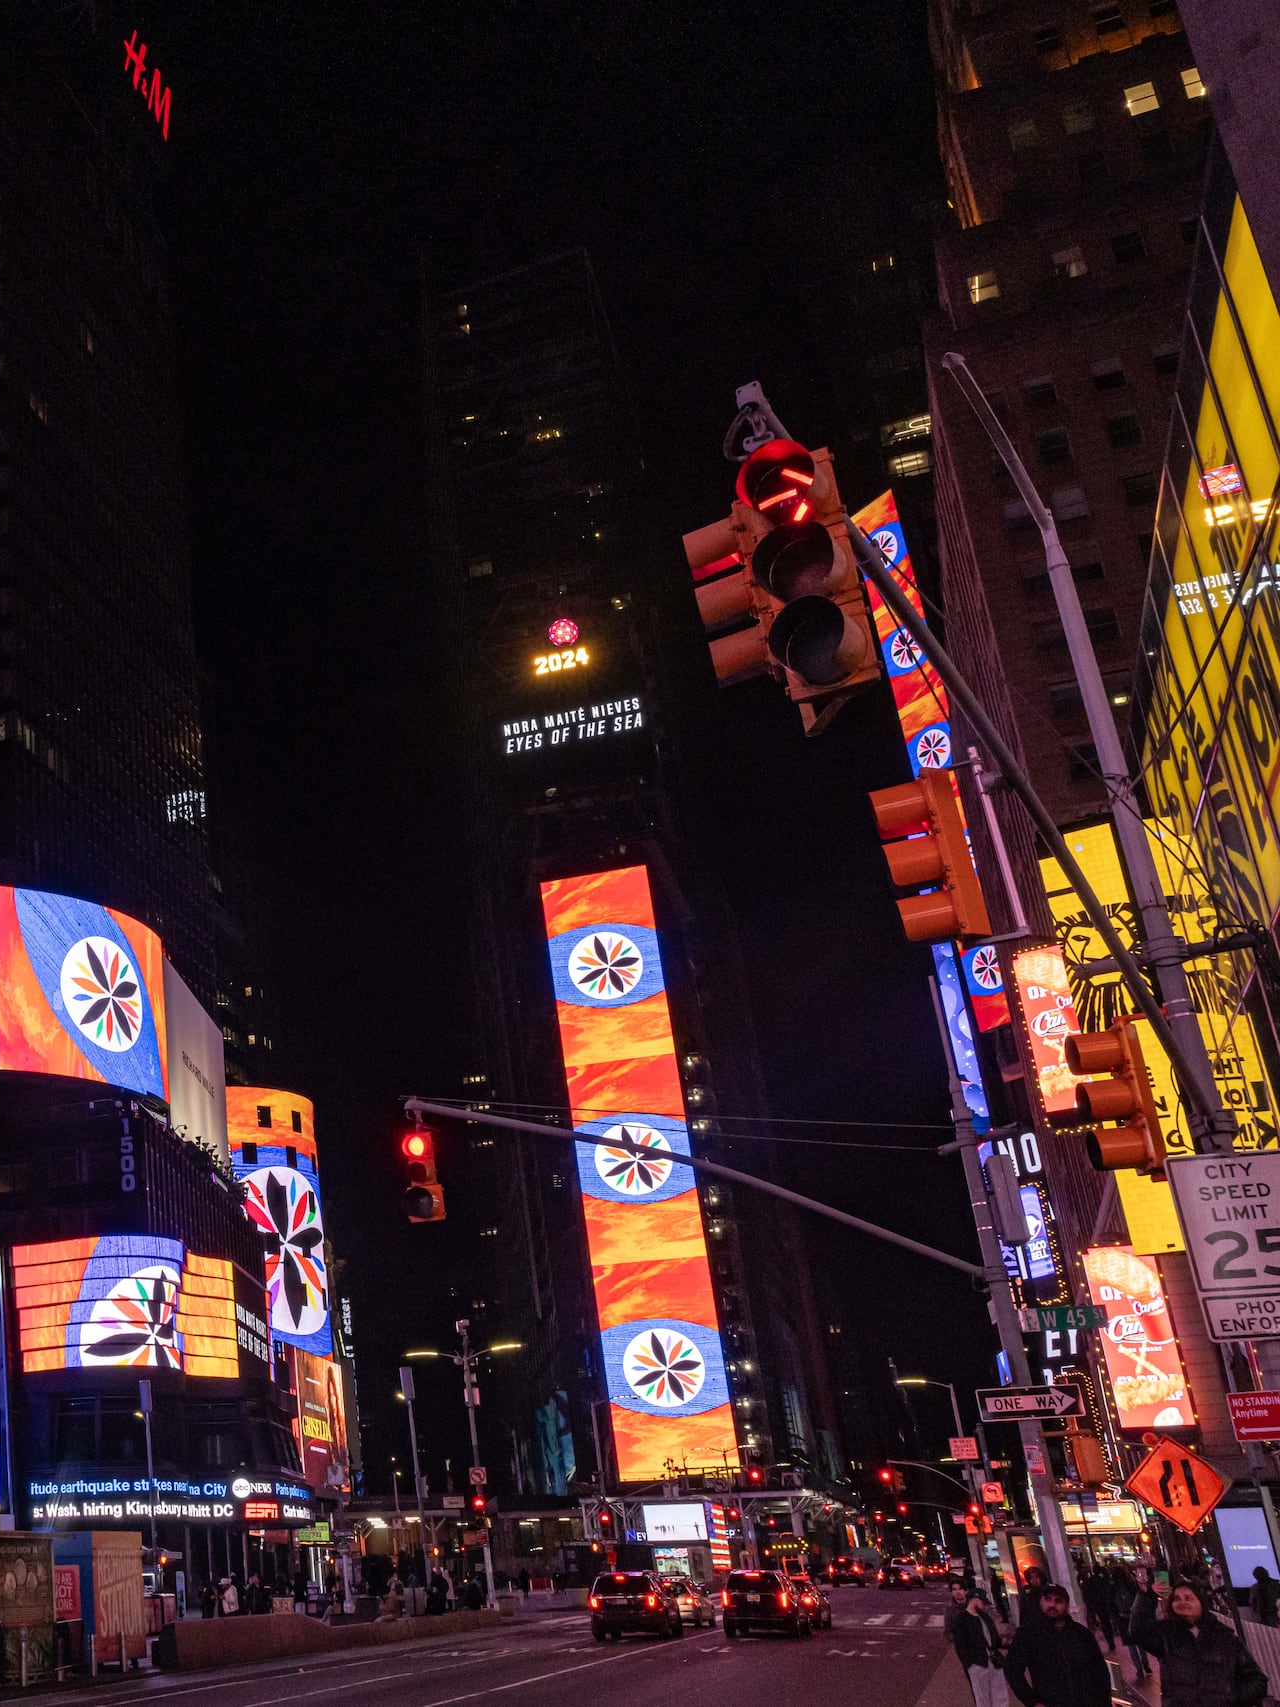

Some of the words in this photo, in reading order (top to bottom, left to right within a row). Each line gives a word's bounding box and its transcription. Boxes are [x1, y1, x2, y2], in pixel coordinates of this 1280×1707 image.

[124, 30, 171, 141] H&M
[535, 648, 589, 675] 2024
[503, 719, 538, 736] NORA
[545, 707, 585, 728] MAITÉ
[592, 697, 640, 718] NIEVES
[506, 733, 543, 753] EYES
[551, 727, 570, 744] OF
[578, 720, 606, 739] THE
[614, 712, 642, 732] SEA
[1204, 1162, 1252, 1180] CITY
[1198, 1183, 1271, 1201] SPEED
[1212, 1204, 1269, 1222] LIMIT
[1028, 1241, 1047, 1253] TACO
[1031, 1250, 1048, 1261] BELL
[1041, 1310, 1057, 1328] W
[1066, 1309, 1087, 1327] 45
[994, 1398, 1024, 1410] ONE
[1035, 1394, 1064, 1408] WAY
[1232, 1397, 1245, 1407] NO
[1235, 1407, 1269, 1419] Anytime
[302, 1415, 333, 1442] GRISELDA
[31, 1482, 58, 1495] itude
[60, 1479, 130, 1495] earthquake
[203, 1482, 227, 1497] City
[250, 1483, 272, 1493] NEWS
[46, 1502, 80, 1517] Wash.
[83, 1501, 123, 1518] hiring
[214, 1505, 233, 1517] DC
[245, 1503, 278, 1518] ESPN
[100, 1576, 141, 1638] STATION
